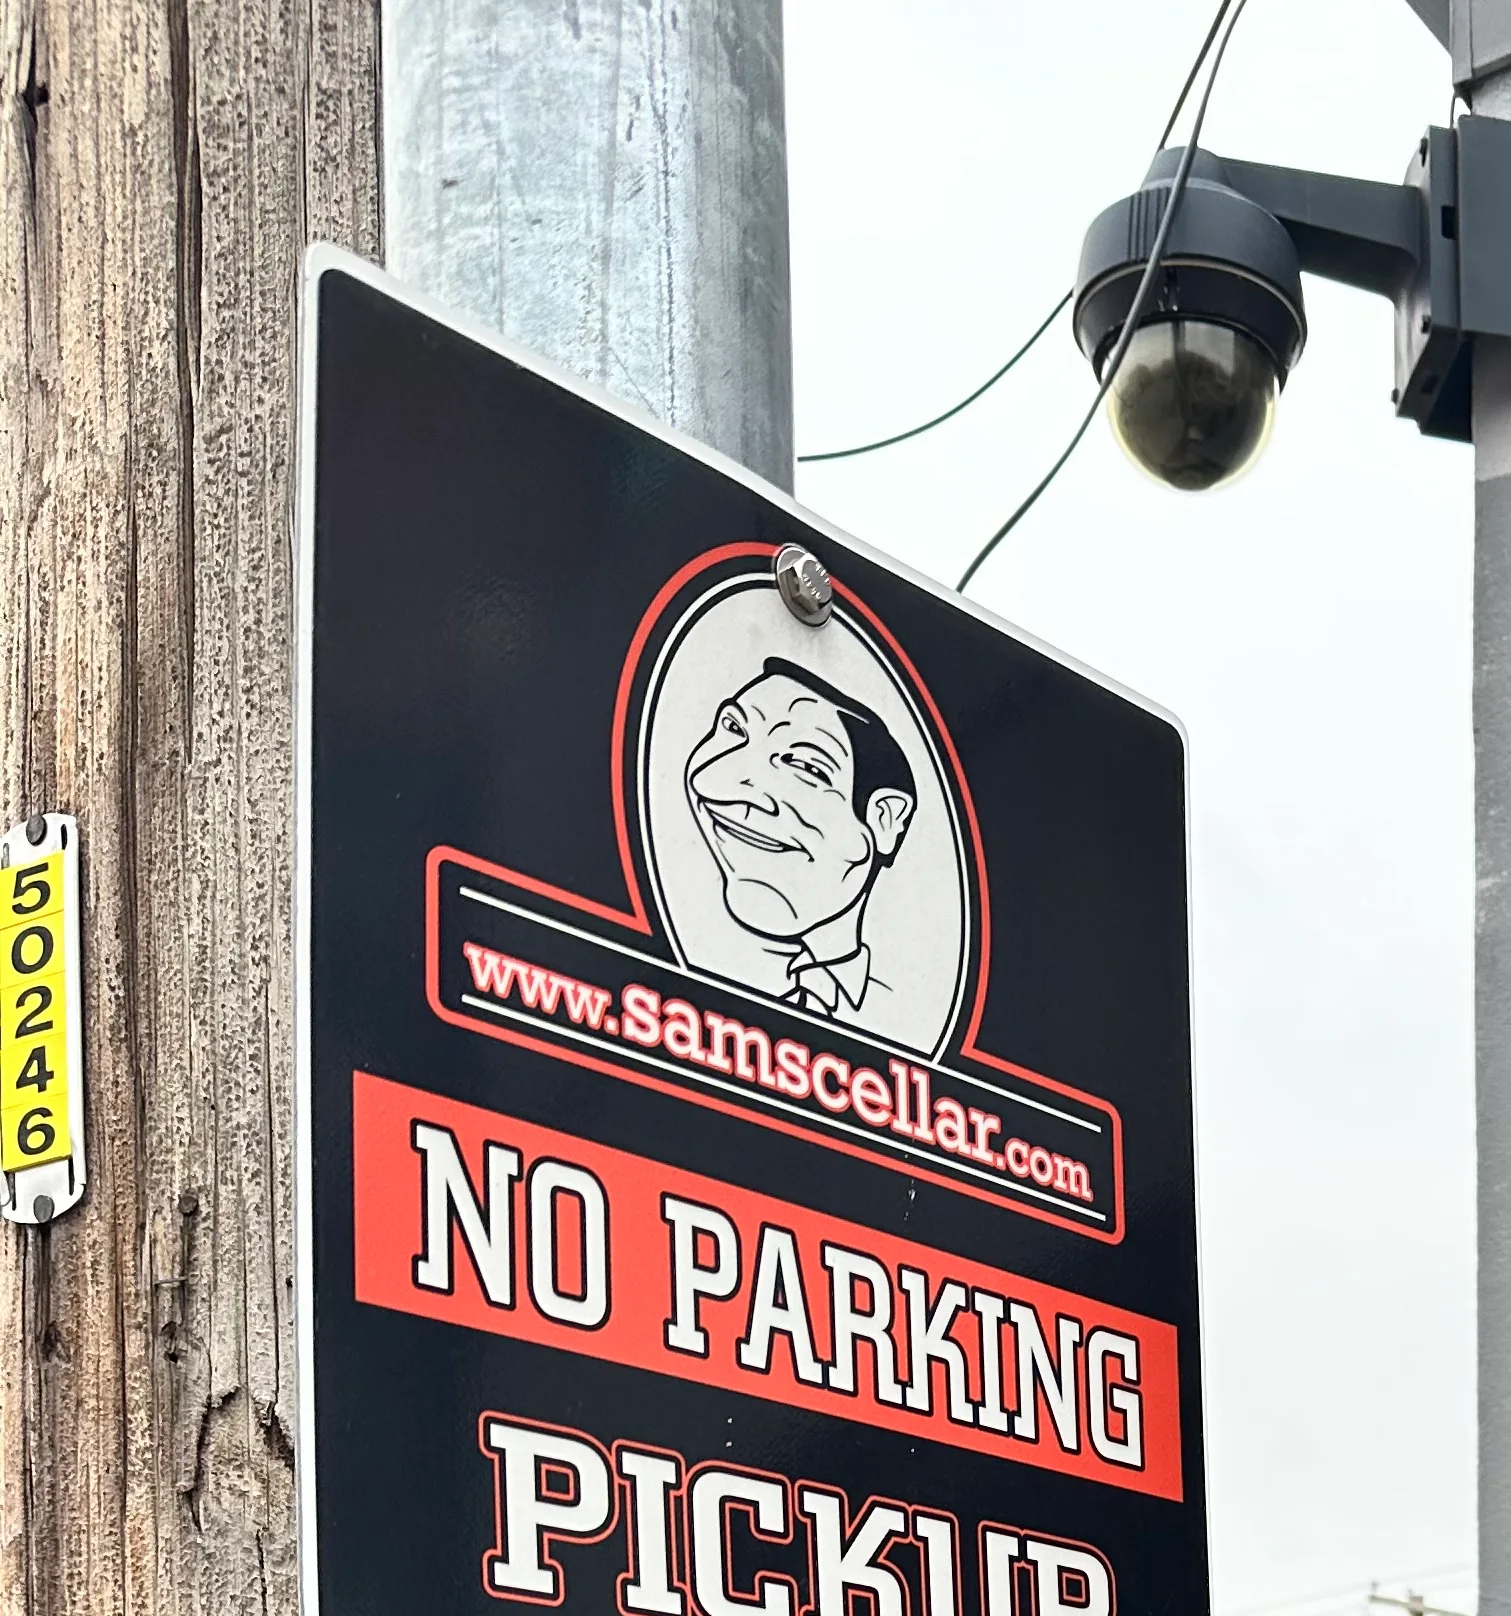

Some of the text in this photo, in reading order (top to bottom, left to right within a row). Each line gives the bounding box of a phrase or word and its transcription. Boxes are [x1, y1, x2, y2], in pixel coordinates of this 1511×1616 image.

[11, 862, 56, 1156] 50246
[464, 941, 1094, 1200] www.samscellar.com
[412, 1122, 1146, 1472] NO PARKING
